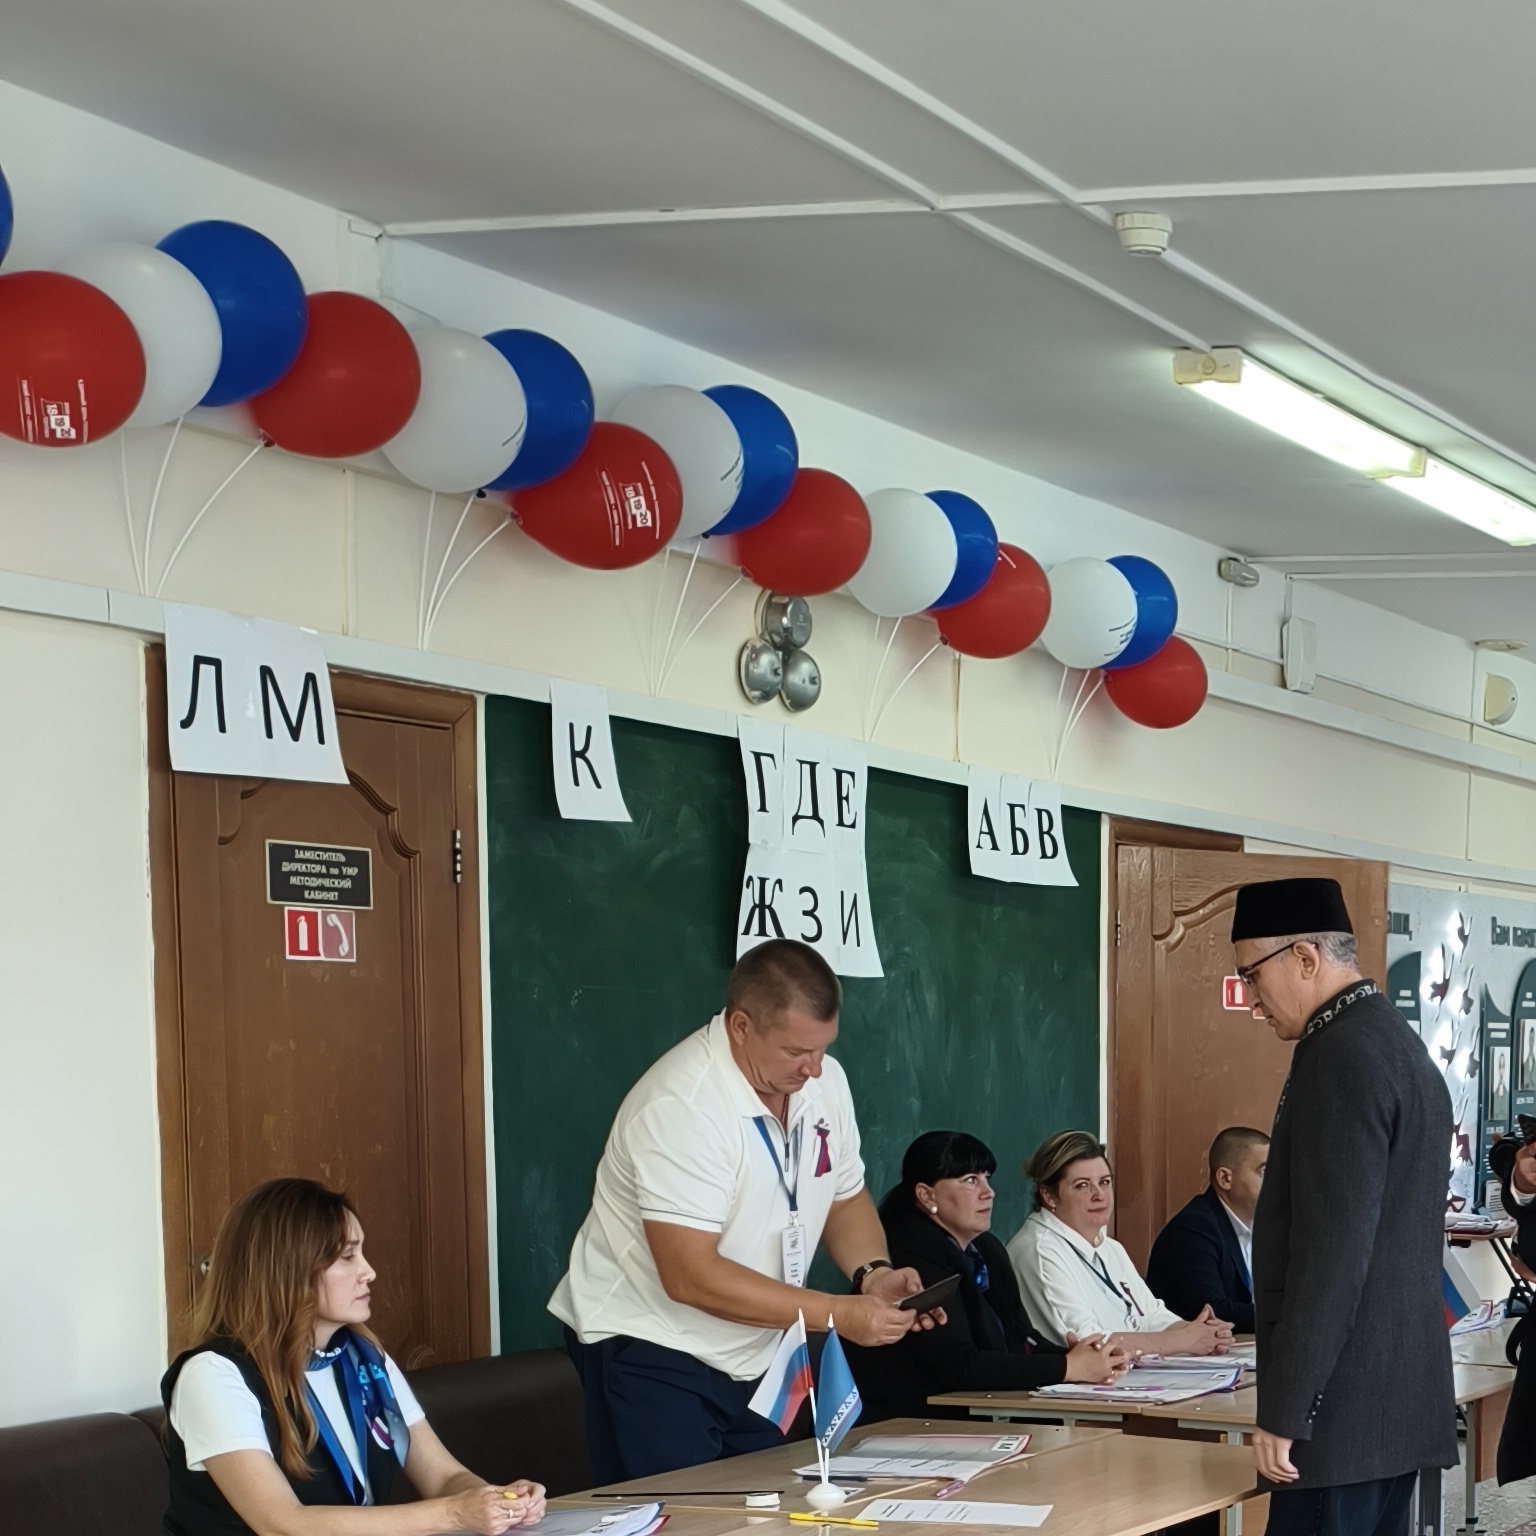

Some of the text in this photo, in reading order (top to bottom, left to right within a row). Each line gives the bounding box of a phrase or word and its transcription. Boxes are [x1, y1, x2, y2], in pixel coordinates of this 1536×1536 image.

[180, 654, 326, 746] Л М
[568, 721, 603, 790] К
[975, 795, 1059, 860] АБВ
[281, 861, 328, 874] ДИРЕКТОРА
[289, 875, 352, 889] МЕТОДИЧЕСКИЙ
[304, 889, 339, 901] КАБИНЕТ
